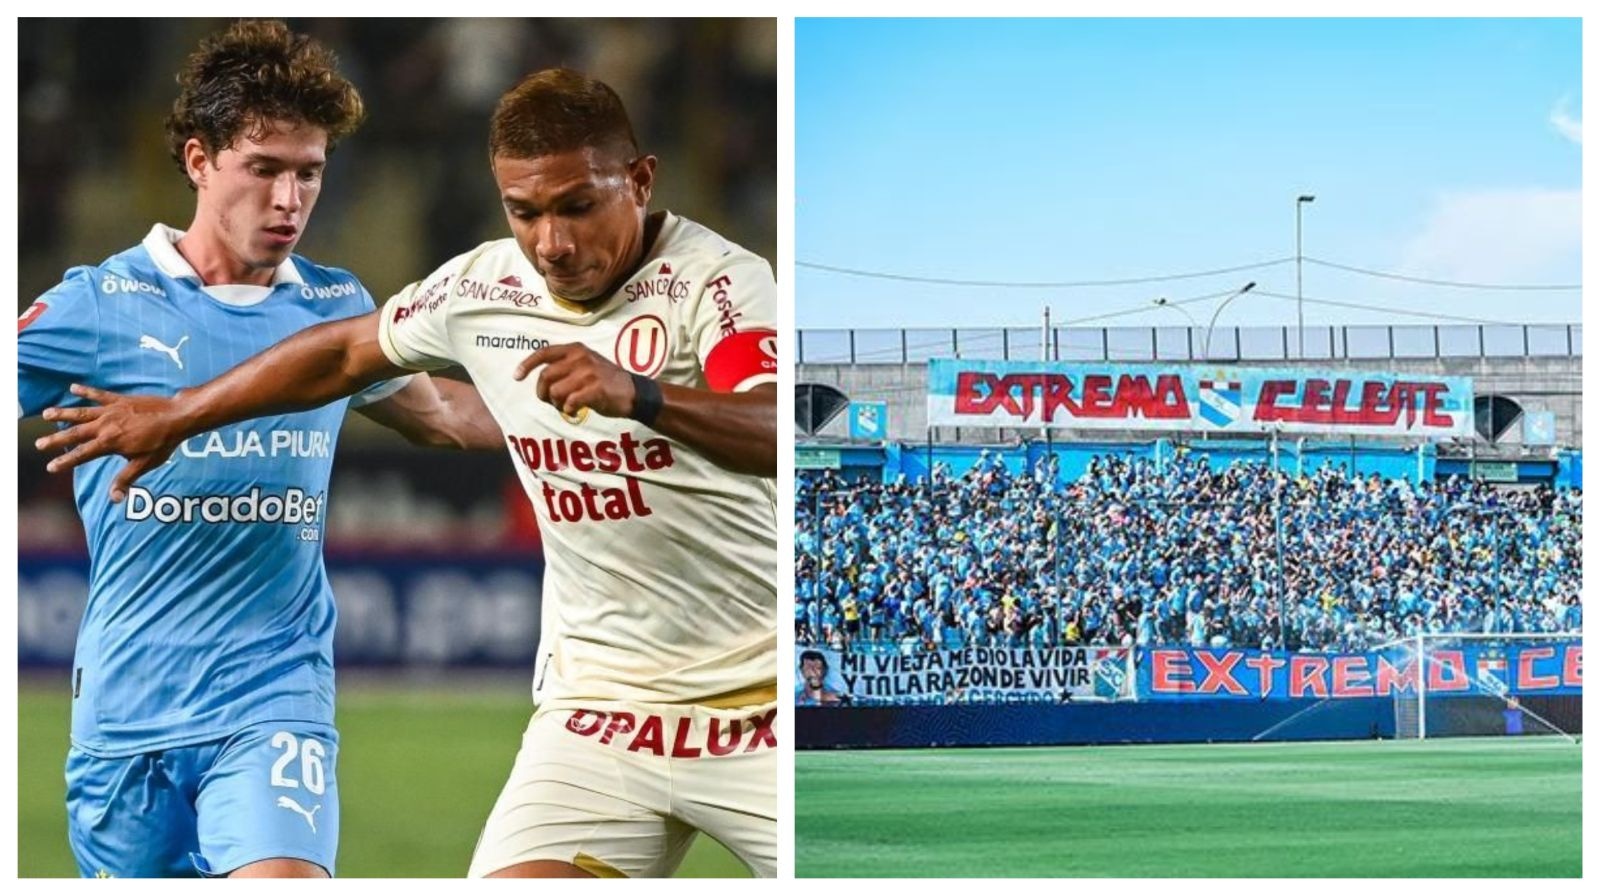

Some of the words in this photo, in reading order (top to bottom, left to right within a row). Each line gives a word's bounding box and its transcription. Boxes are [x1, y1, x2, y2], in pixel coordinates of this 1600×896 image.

[314, 281, 356, 299] WOW
[457, 279, 489, 300] SAN
[489, 286, 542, 307] CARLOS
[624, 280, 655, 303] SAN
[475, 335, 550, 350] marathon
[953, 371, 1192, 423] EXTREMO
[180, 430, 266, 458] CAJA
[508, 431, 676, 478] apuesta
[125, 485, 325, 525] DoradoBet
[542, 475, 654, 523] total
[840, 653, 866, 672] MI
[873, 652, 943, 673] VIEJA
[948, 648, 973, 668] ME
[976, 649, 1007, 666] DIO
[1011, 650, 1036, 668] LA
[1037, 648, 1088, 668] VIDA
[840, 673, 857, 695] Y
[893, 674, 923, 695] LA
[1000, 669, 1026, 689] DE
[1030, 667, 1091, 688] VIVIR
[565, 708, 777, 758] OPALUX
[271, 730, 325, 796] 26
